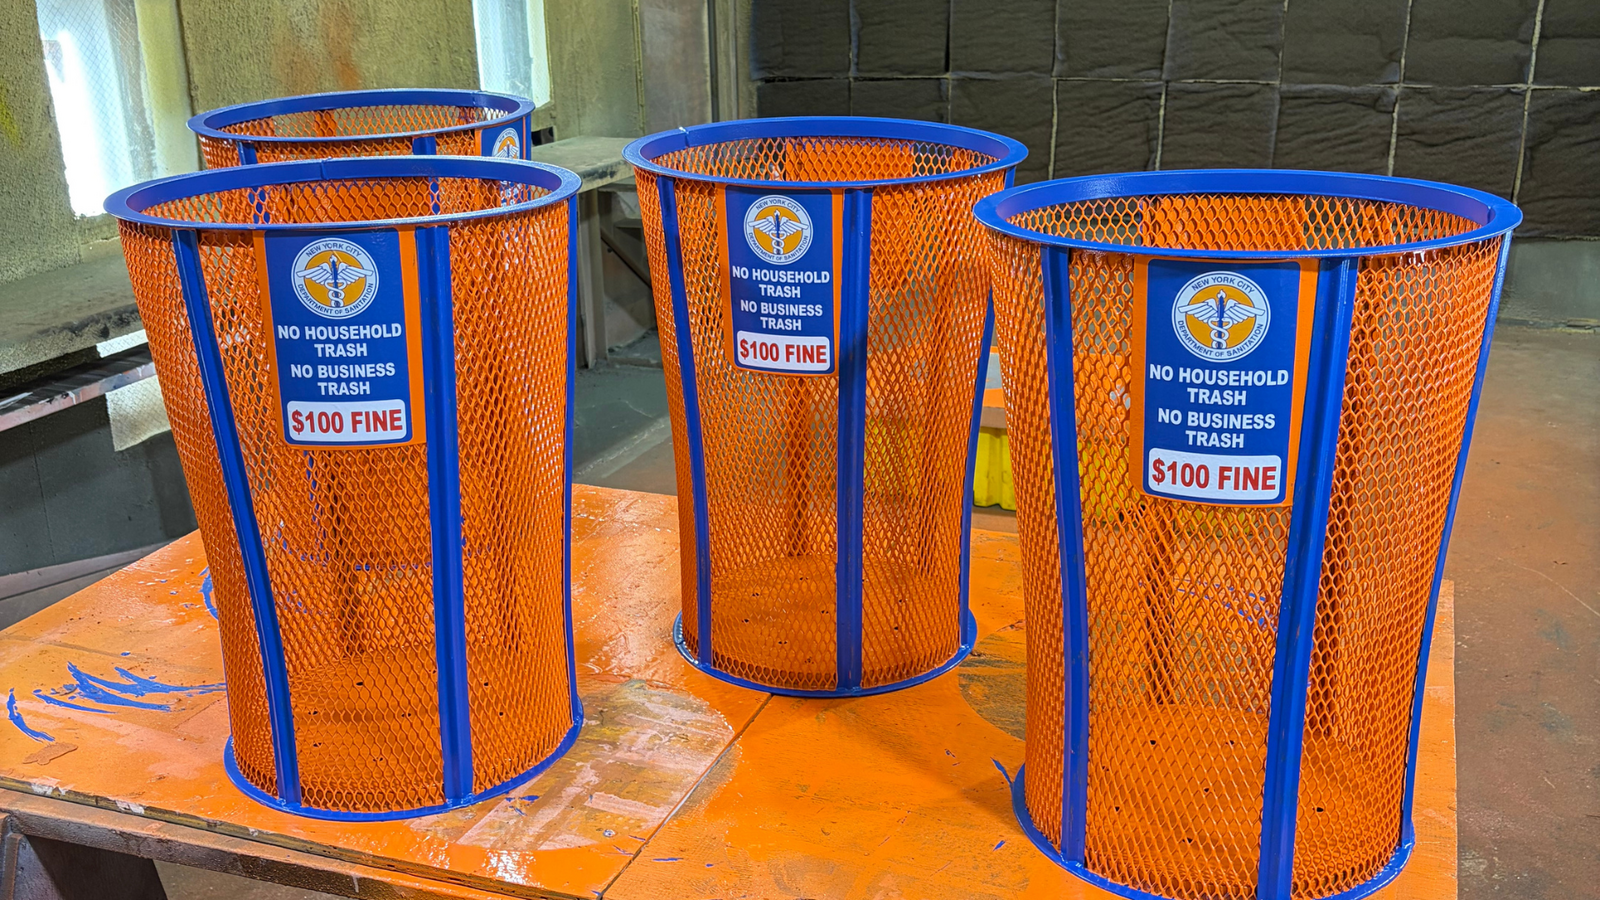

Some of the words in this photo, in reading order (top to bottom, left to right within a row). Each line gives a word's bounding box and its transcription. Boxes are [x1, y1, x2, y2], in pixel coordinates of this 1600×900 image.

[756, 200, 768, 210] NEW
[787, 202, 800, 212] CITY
[305, 245, 320, 257] NEW
[345, 245, 362, 256] CITY
[749, 232, 774, 260] DEPARTMENT
[784, 235, 808, 260] SANITATION
[732, 265, 749, 279] NO
[752, 268, 830, 284] HOUSEHOLD
[759, 284, 801, 298] TRASH
[1191, 278, 1209, 291] NEW
[1211, 276, 1235, 284] YORK
[1237, 280, 1255, 294] CITY
[298, 283, 333, 314] DEPARTMENT
[344, 282, 373, 314] SANITATION
[740, 300, 757, 313] NO
[761, 302, 823, 316] BUSINESS
[277, 324, 300, 340] NO
[305, 323, 402, 340] HOUSEHOLD
[760, 317, 802, 331] TRASH
[1178, 320, 1213, 356] DEPARTMENT
[1227, 323, 1263, 357] SANITATION
[314, 343, 368, 358] TRASH
[740, 338, 779, 362] $100
[785, 343, 827, 364] FINE
[290, 364, 313, 378] NO
[318, 362, 395, 378] BUSINESS
[1150, 364, 1174, 382] NO
[1179, 367, 1289, 386] HOUSEHOLD
[317, 381, 370, 395] TRASH
[1187, 388, 1246, 406] TRASH
[291, 409, 344, 435] $100
[351, 409, 403, 433] FINE
[1158, 408, 1182, 425] NO
[1187, 411, 1275, 430] BUSINESS
[1185, 430, 1244, 448] TRASH
[1152, 457, 1209, 489] $100
[1218, 466, 1277, 491] FINE
